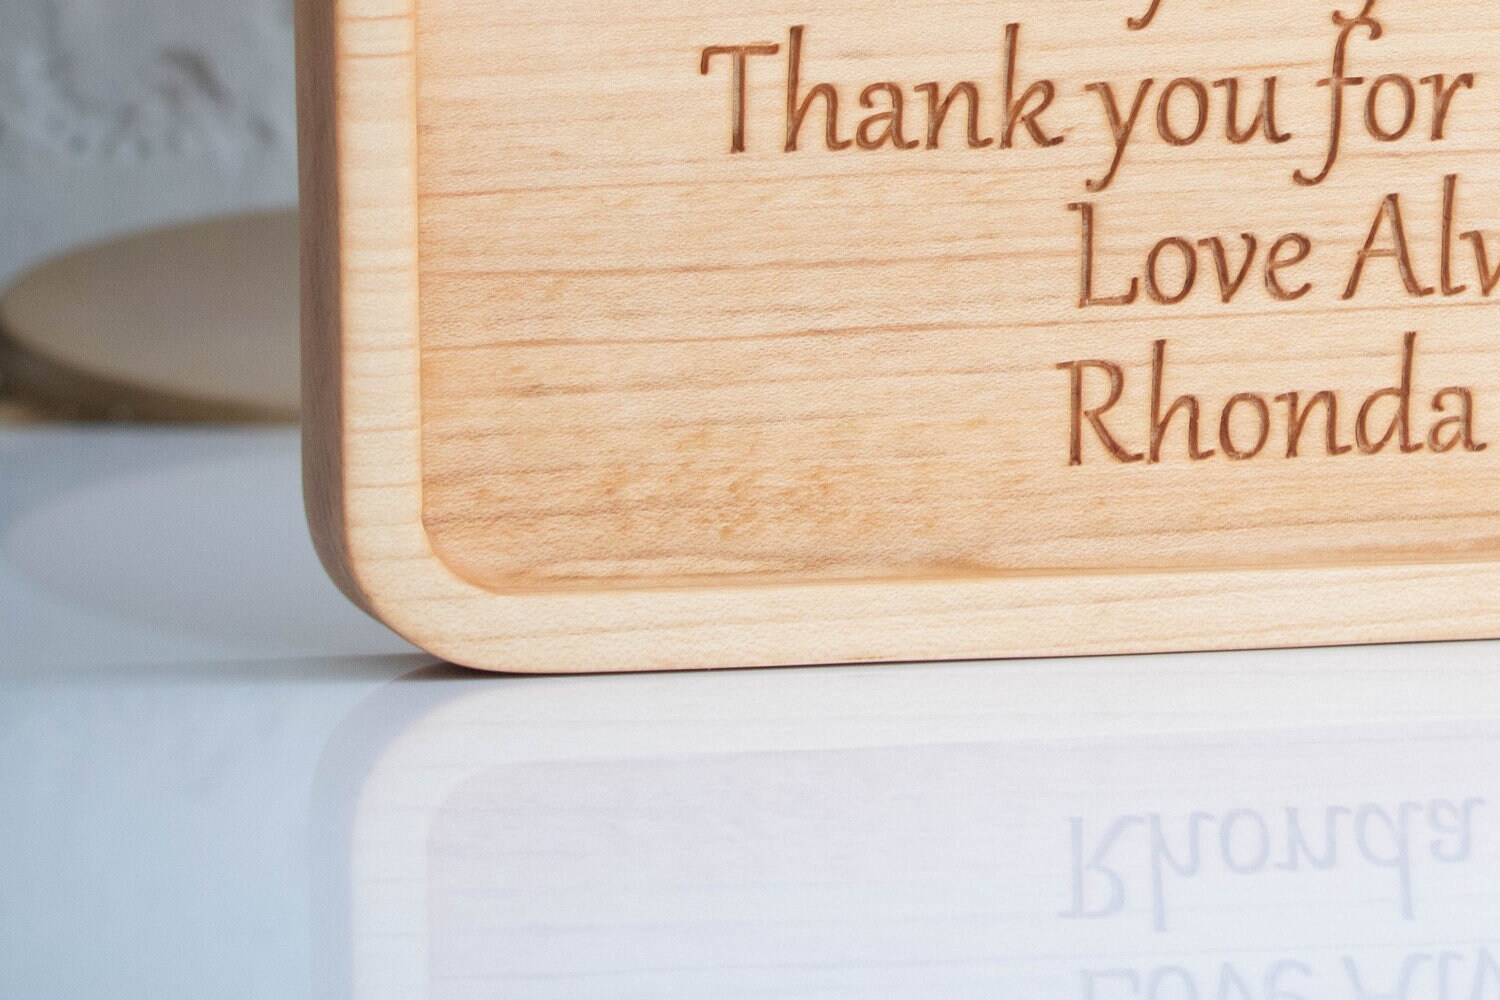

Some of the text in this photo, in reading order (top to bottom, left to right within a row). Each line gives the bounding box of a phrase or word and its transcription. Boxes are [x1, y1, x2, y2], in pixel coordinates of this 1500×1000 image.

[700, 23, 1064, 153] Thank
[1085, 77, 1291, 191] you
[1292, 15, 1473, 186] for
[1066, 202, 1313, 309] Love
[1054, 331, 1488, 467] Rhonda
